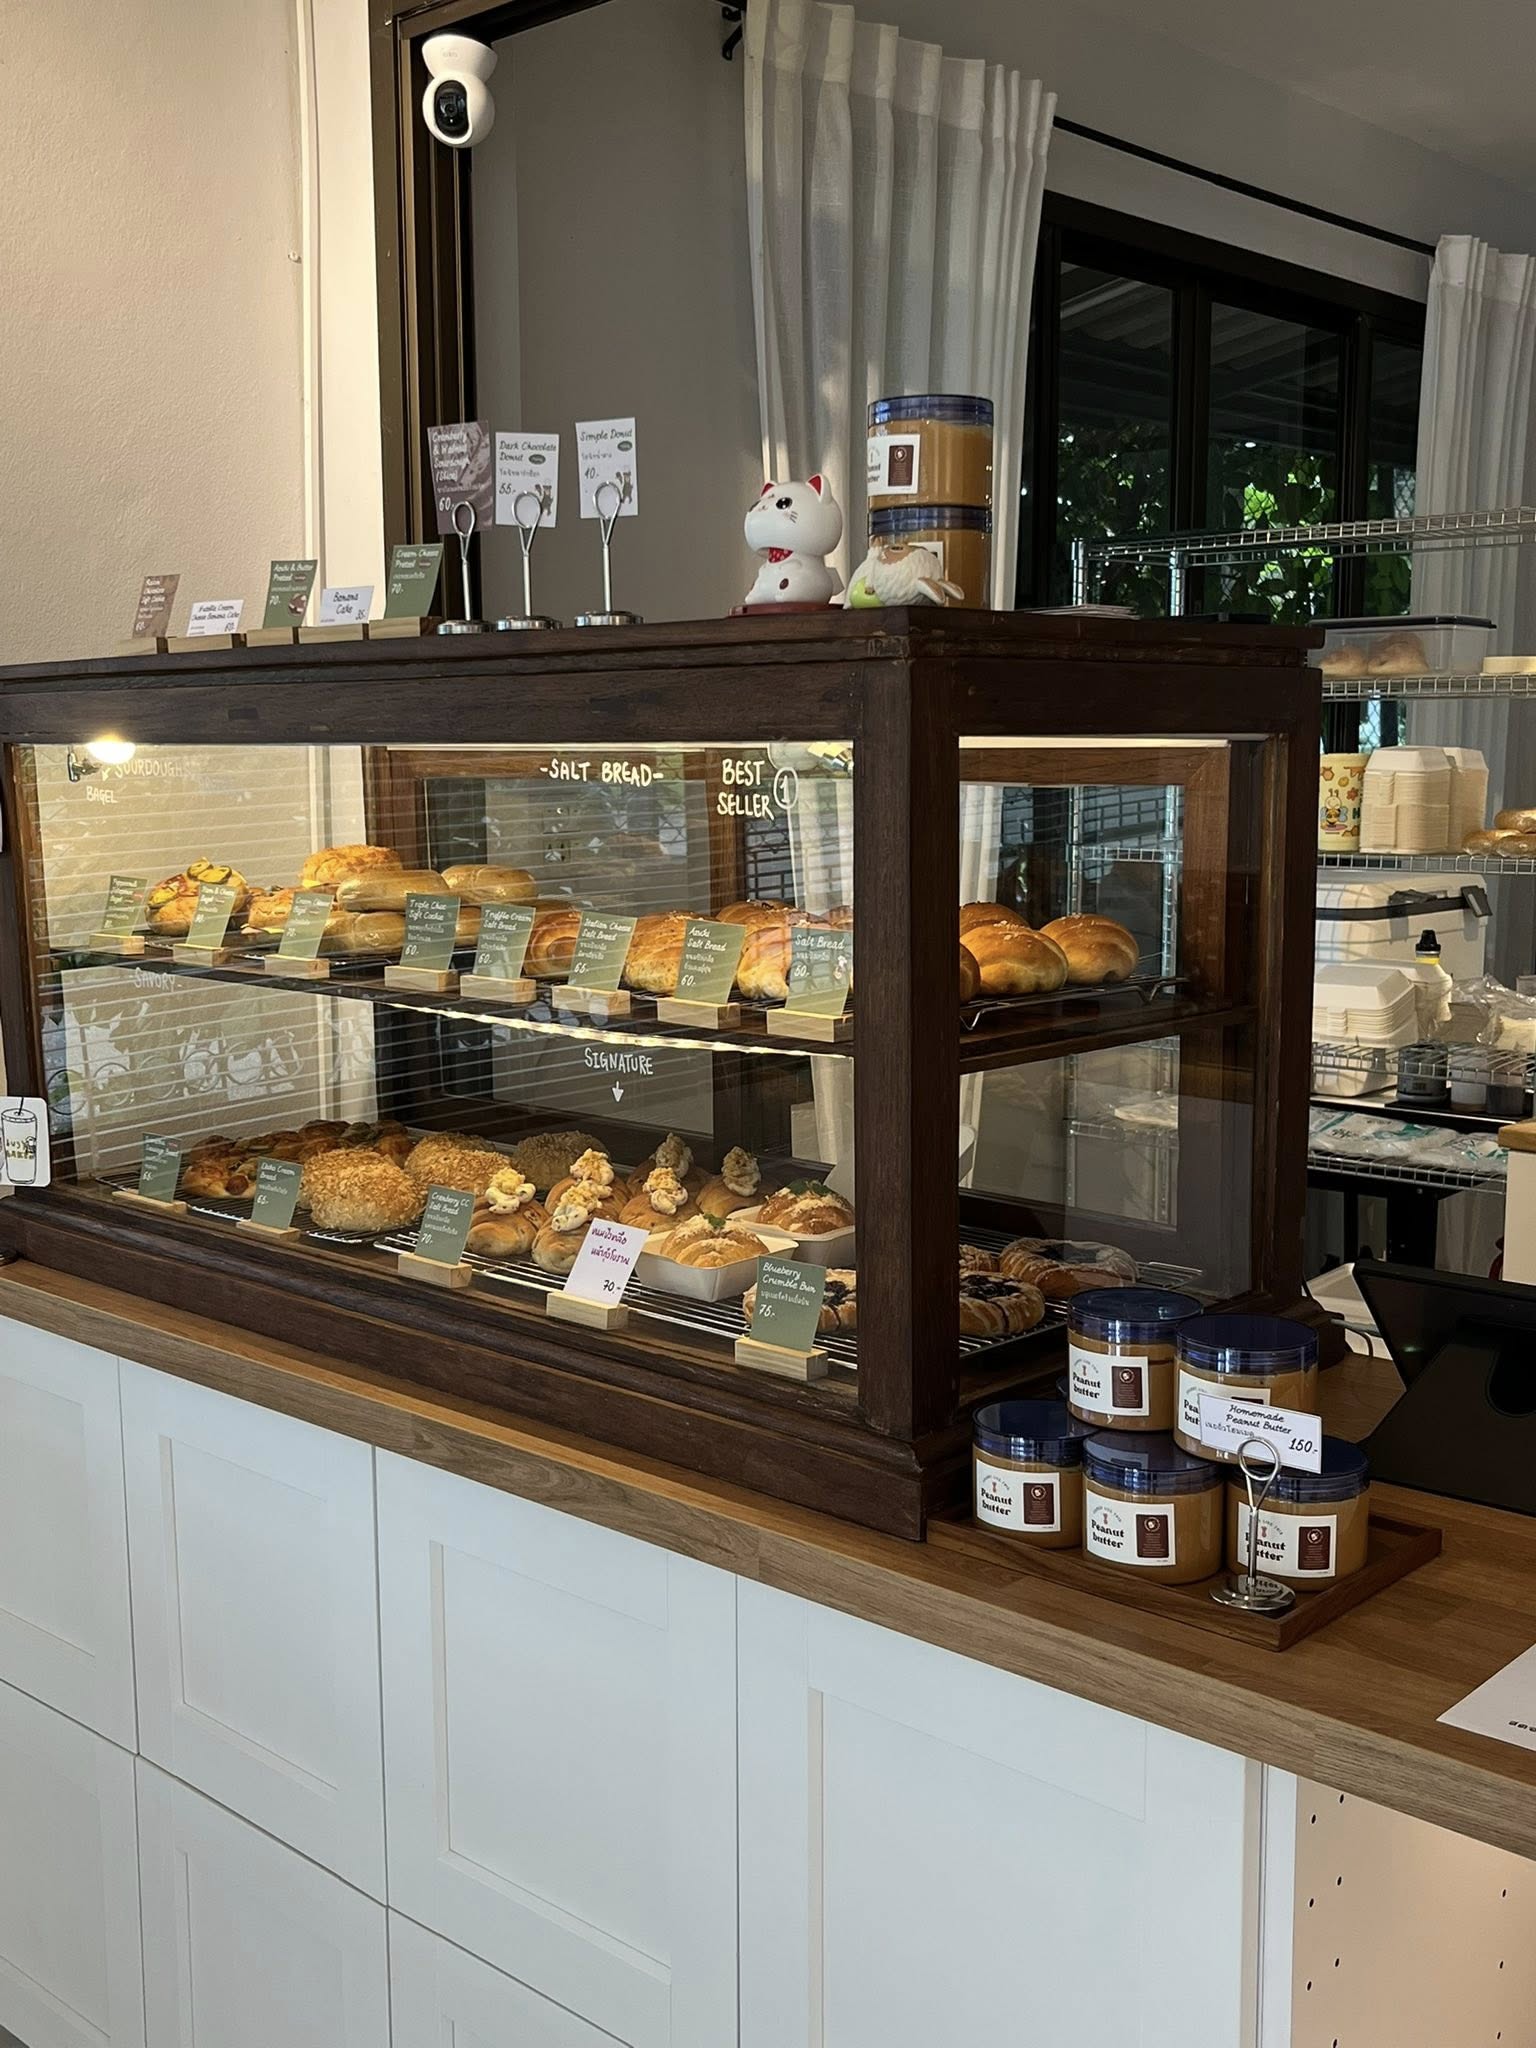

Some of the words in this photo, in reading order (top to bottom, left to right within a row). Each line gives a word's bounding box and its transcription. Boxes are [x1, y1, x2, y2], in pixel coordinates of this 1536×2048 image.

[580, 430, 608, 443] Simple
[610, 428, 633, 439] Donut
[499, 440, 519, 450] Dark
[522, 441, 557, 451] Chocolate
[500, 451, 523, 462] Donut
[333, 592, 359, 602] Banana
[336, 604, 353, 615] Cake
[722, 759, 765, 786] BEST
[86, 785, 117, 805] BAGEL
[717, 791, 774, 820] SELLER
[410, 899, 430, 910] Triple
[431, 901, 447, 910] Choc
[409, 910, 423, 921] Soft
[423, 911, 444, 921] Cookie
[485, 910, 510, 921] Truffle
[510, 912, 532, 922] Cream
[483, 920, 497, 928] Salt
[498, 921, 518, 931] Bread
[584, 918, 608, 929] Italian
[609, 922, 632, 932] Cheese
[582, 928, 597, 938] Salt
[597, 930, 618, 941] Bread
[795, 934, 815, 947] Salt
[816, 936, 845, 949] Bread
[687, 938, 704, 949] Salt
[704, 940, 728, 951] Bread
[585, 1047, 654, 1075] SIGNATURE
[259, 1171, 278, 1181] Bread
[277, 1165, 295, 1176] Cream
[431, 1192, 459, 1208] Cranberry
[460, 1198, 470, 1207] CC
[429, 1201, 441, 1211] Salt
[441, 1204, 460, 1216] Bread
[762, 1262, 801, 1281] Blueberry
[762, 1274, 798, 1290] Crumble
[799, 1281, 816, 1294] Bun
[1073, 1372, 1101, 1388] Peanut
[1073, 1384, 1100, 1399] butter
[1184, 1400, 1199, 1414] Pea
[1229, 1405, 1285, 1422] Homemade
[1184, 1412, 1200, 1425] but
[1226, 1414, 1260, 1428] Peanut
[1263, 1421, 1292, 1434] Butter
[981, 1488, 1012, 1505] Peanut
[982, 1500, 1011, 1516] butter
[1091, 1519, 1125, 1538] Peanut
[1092, 1532, 1123, 1548] butter
[1245, 1532, 1286, 1550] anut
[1246, 1544, 1284, 1561] tter
